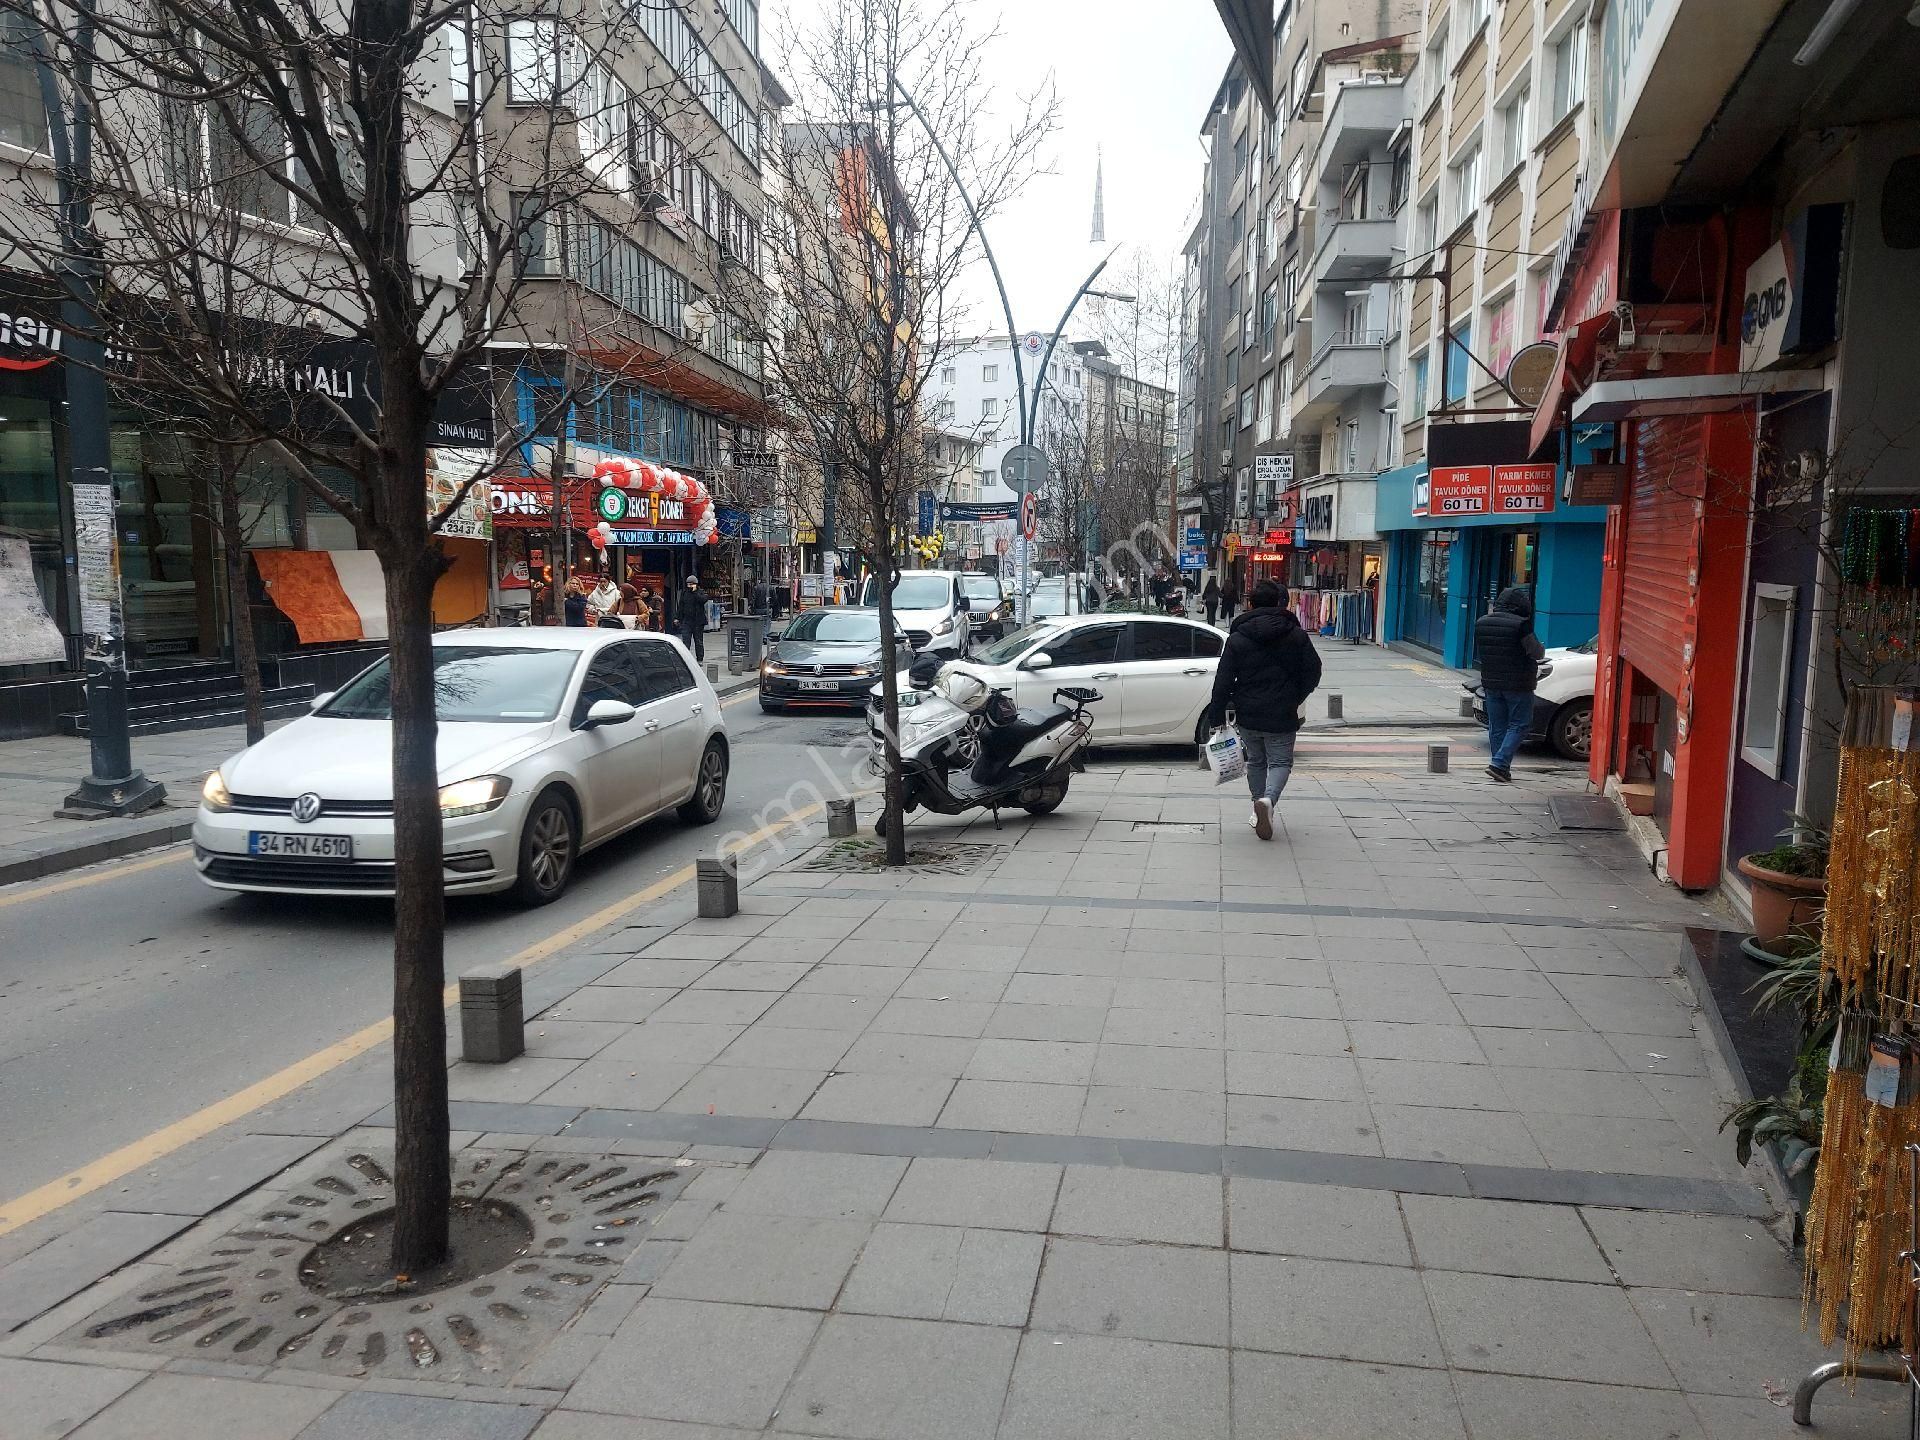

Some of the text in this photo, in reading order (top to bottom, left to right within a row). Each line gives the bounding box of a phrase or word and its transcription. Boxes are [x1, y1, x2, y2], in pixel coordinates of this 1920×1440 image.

[1758, 277, 1787, 330] QNB
[294, 364, 354, 399] HALI
[438, 420, 487, 442] SİNAN HALI
[1452, 473, 1470, 482] PİDE
[1499, 470, 1552, 481] YARIM EKMEK
[1435, 486, 1459, 496] TAVUK
[1461, 484, 1487, 495] DÖNER
[1498, 482, 1552, 494] TAVUK DÖNER
[659, 496, 684, 520] DÖNER
[1443, 498, 1481, 510] 60 TL
[1505, 496, 1543, 508] 60 TL
[258, 834, 349, 857] 34 RN 4610
